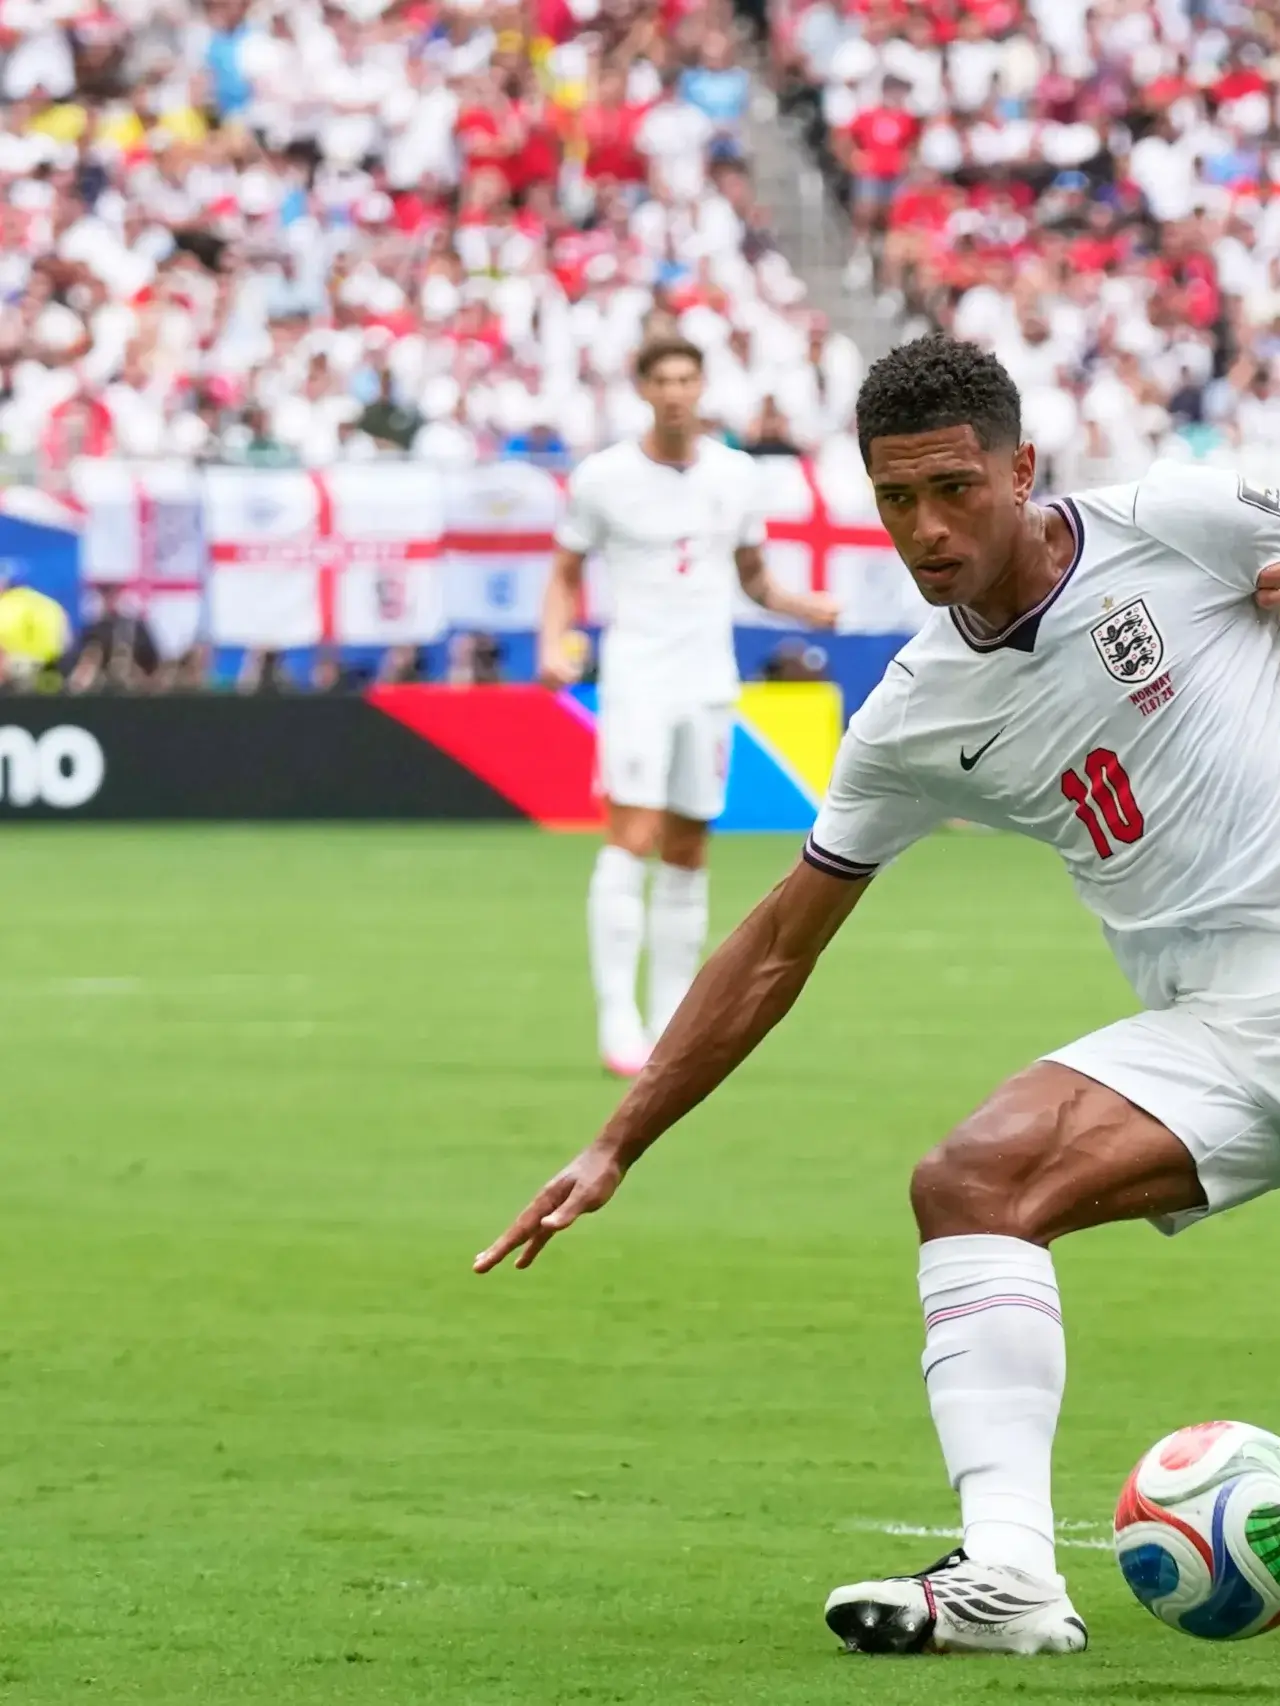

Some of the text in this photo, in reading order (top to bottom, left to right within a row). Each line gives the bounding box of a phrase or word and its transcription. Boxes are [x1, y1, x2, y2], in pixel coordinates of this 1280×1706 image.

[1129, 671, 1171, 705] NORWAY
[1139, 686, 1175, 716] 11.07.26
[1061, 747, 1144, 860] 10
